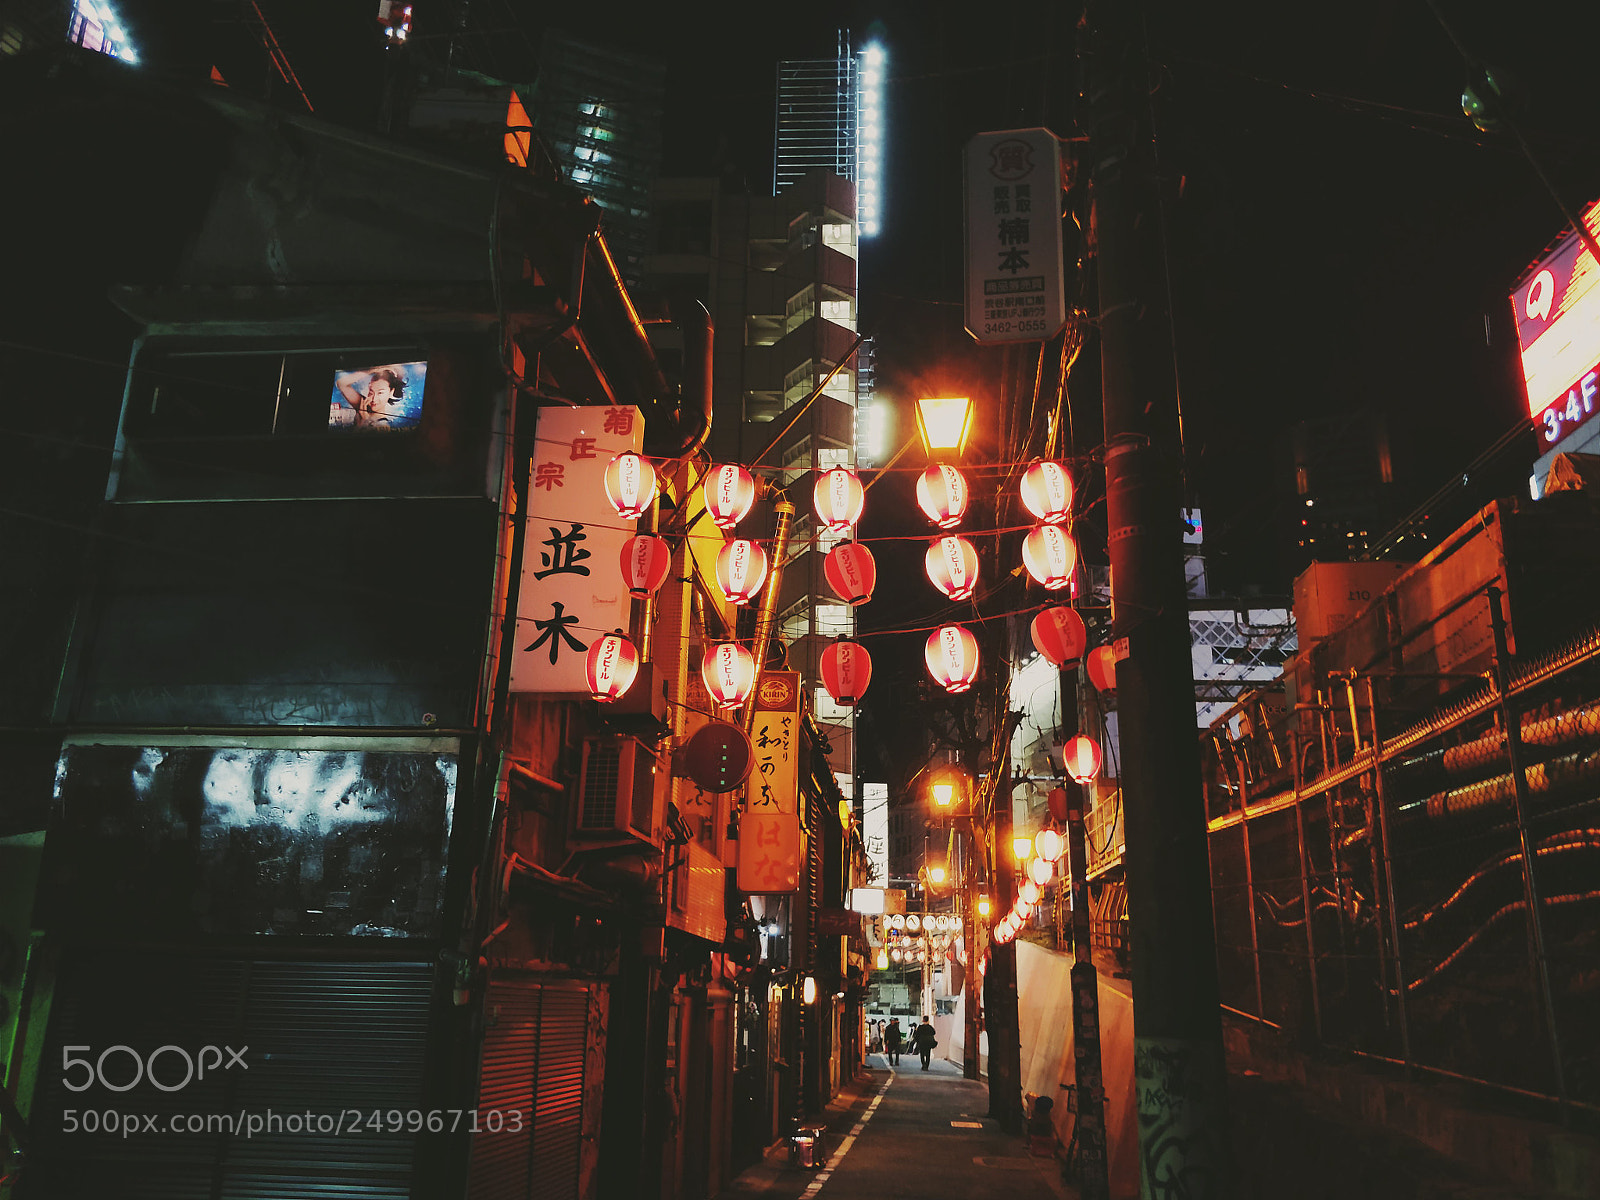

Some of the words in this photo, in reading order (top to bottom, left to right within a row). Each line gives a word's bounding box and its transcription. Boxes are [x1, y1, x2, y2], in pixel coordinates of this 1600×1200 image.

[998, 217, 1030, 274] 楠本
[985, 319, 1047, 334] 3462-0555
[722, 467, 733, 504] キリンビール
[637, 538, 649, 578] キリンビール
[734, 542, 745, 580] キリンビール
[948, 539, 962, 575] キリンビール
[524, 524, 592, 665] 並木
[600, 639, 616, 680] キリンビール
[722, 647, 734, 687] キリンビール
[841, 644, 852, 685] キリンビール
[945, 629, 960, 668] キリンビール
[763, 691, 786, 699] KIRIN
[780, 716, 792, 762] やきとり
[754, 820, 781, 886] はな
